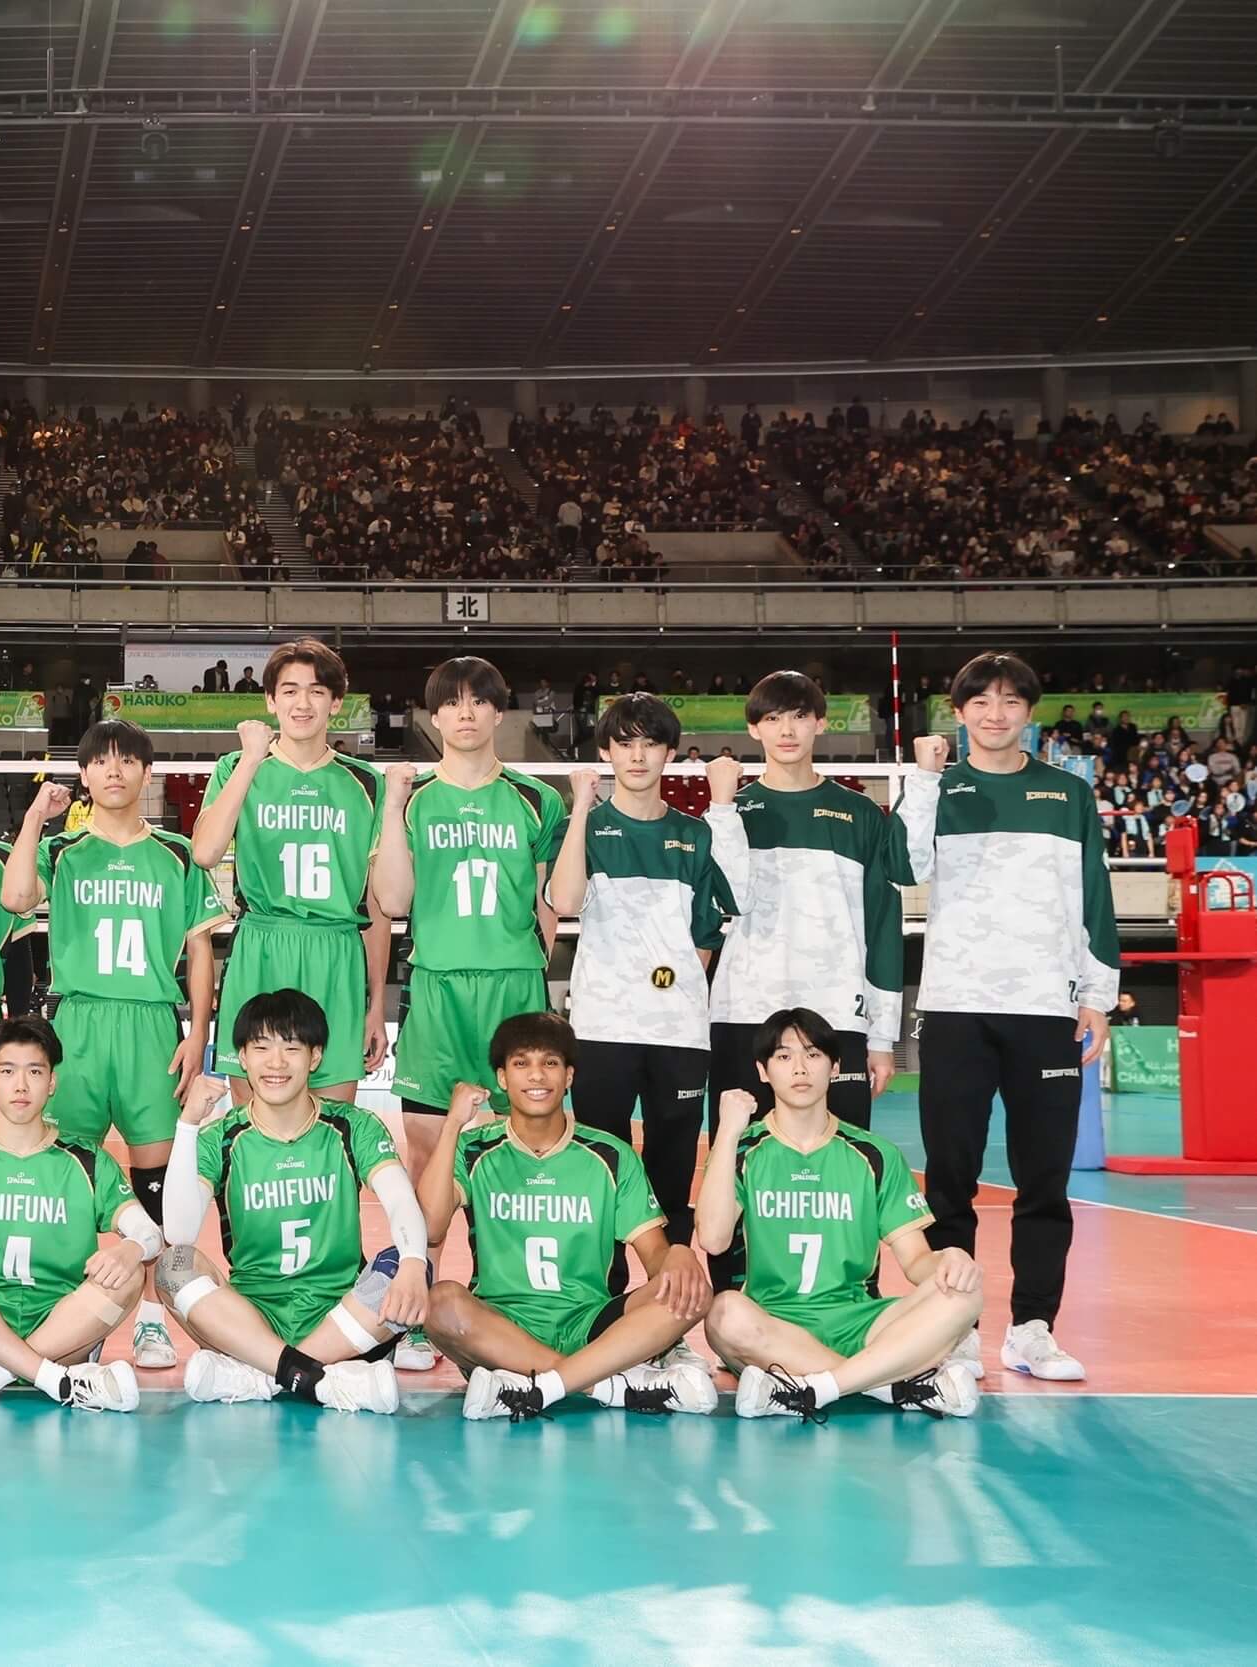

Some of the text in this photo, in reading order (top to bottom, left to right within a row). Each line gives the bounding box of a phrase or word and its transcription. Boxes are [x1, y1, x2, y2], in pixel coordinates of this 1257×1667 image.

[456, 595, 479, 618] 北
[123, 694, 187, 707] HARUKO
[1025, 790, 1068, 802] ICHIFUNA
[256, 802, 346, 834] ICHIFUNA
[813, 808, 853, 823] ICHIFUNA
[427, 821, 518, 851] ICHIFUNA
[279, 842, 331, 900] 16
[452, 857, 498, 917] 17
[73, 878, 163, 910] ICHIFUNA
[94, 918, 147, 977] 14
[655, 970, 672, 988] M
[1068, 979, 1080, 1003] 2
[854, 994, 869, 1020] 2
[488, 1191, 594, 1225] ICHIFUNA
[755, 1189, 855, 1222] ICHIFUNA
[2, 1235, 37, 1287] 4
[279, 1218, 312, 1277] 5
[788, 1232, 823, 1295] 7
[525, 1236, 562, 1292] 6
